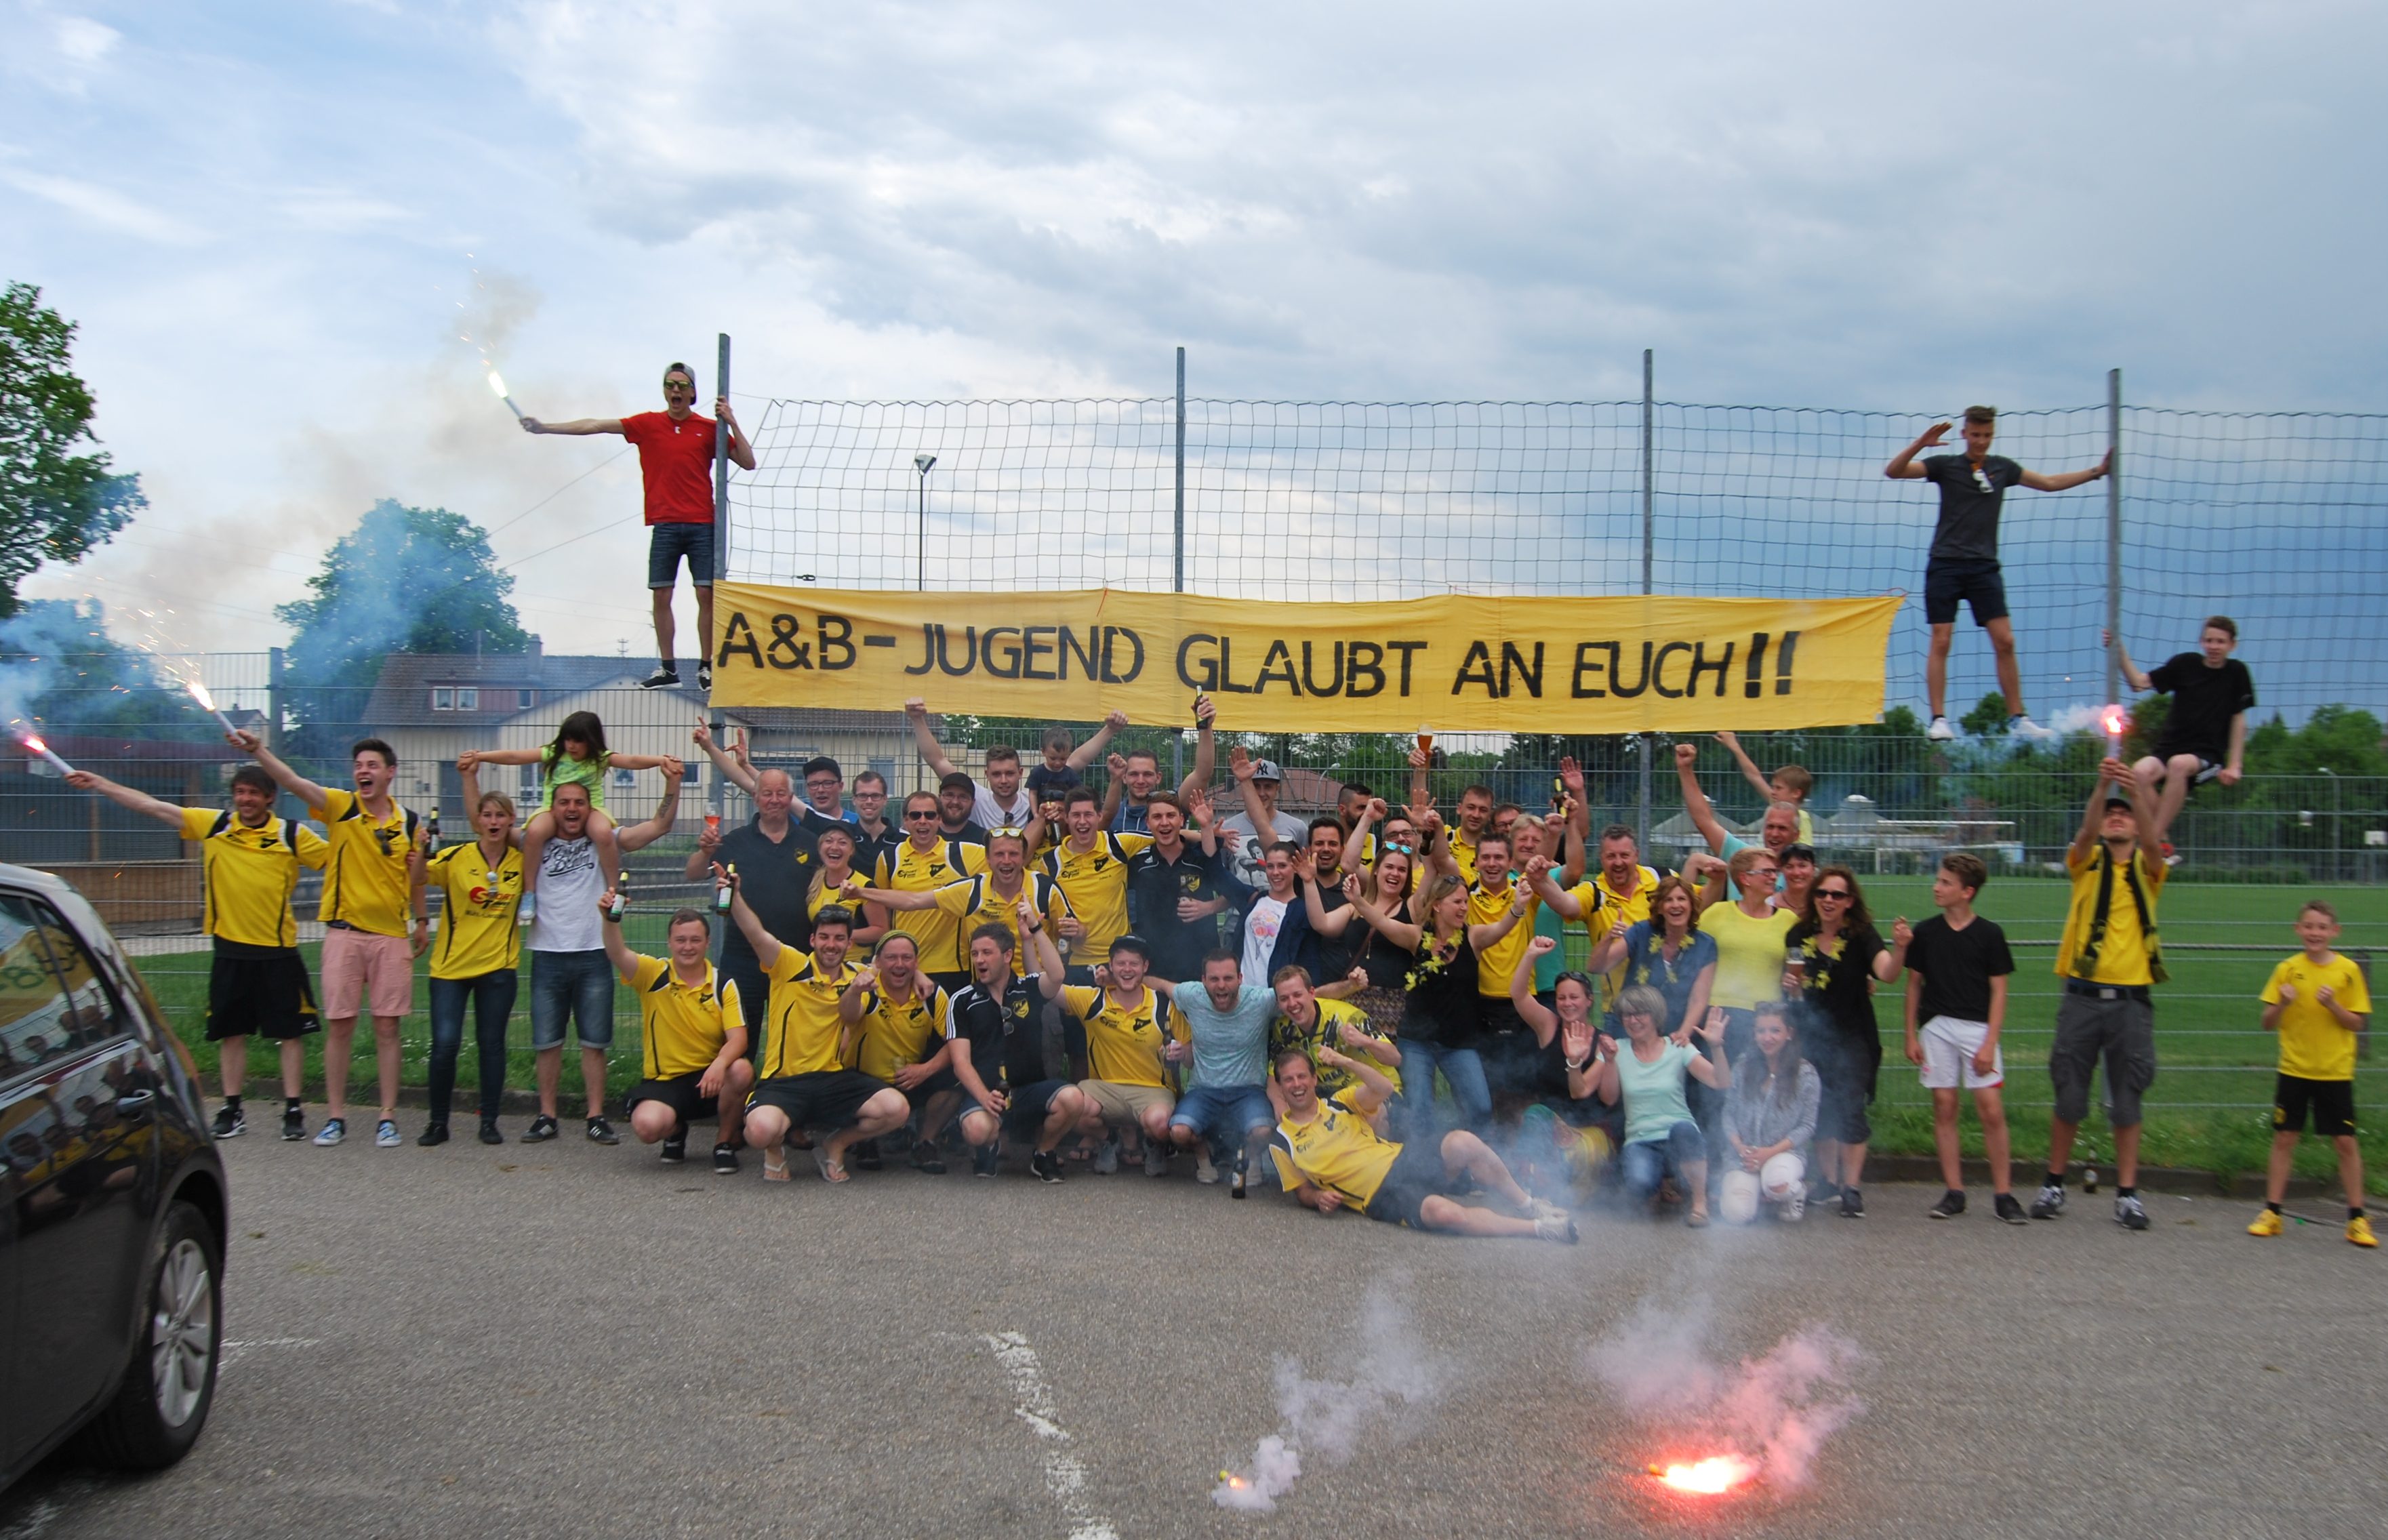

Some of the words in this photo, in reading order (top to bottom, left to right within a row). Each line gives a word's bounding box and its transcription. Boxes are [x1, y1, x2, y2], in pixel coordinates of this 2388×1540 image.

[1176, 634, 1428, 698] GLAUBT
[1451, 640, 1545, 699] AN
[1571, 630, 1801, 699] EUCH!!
